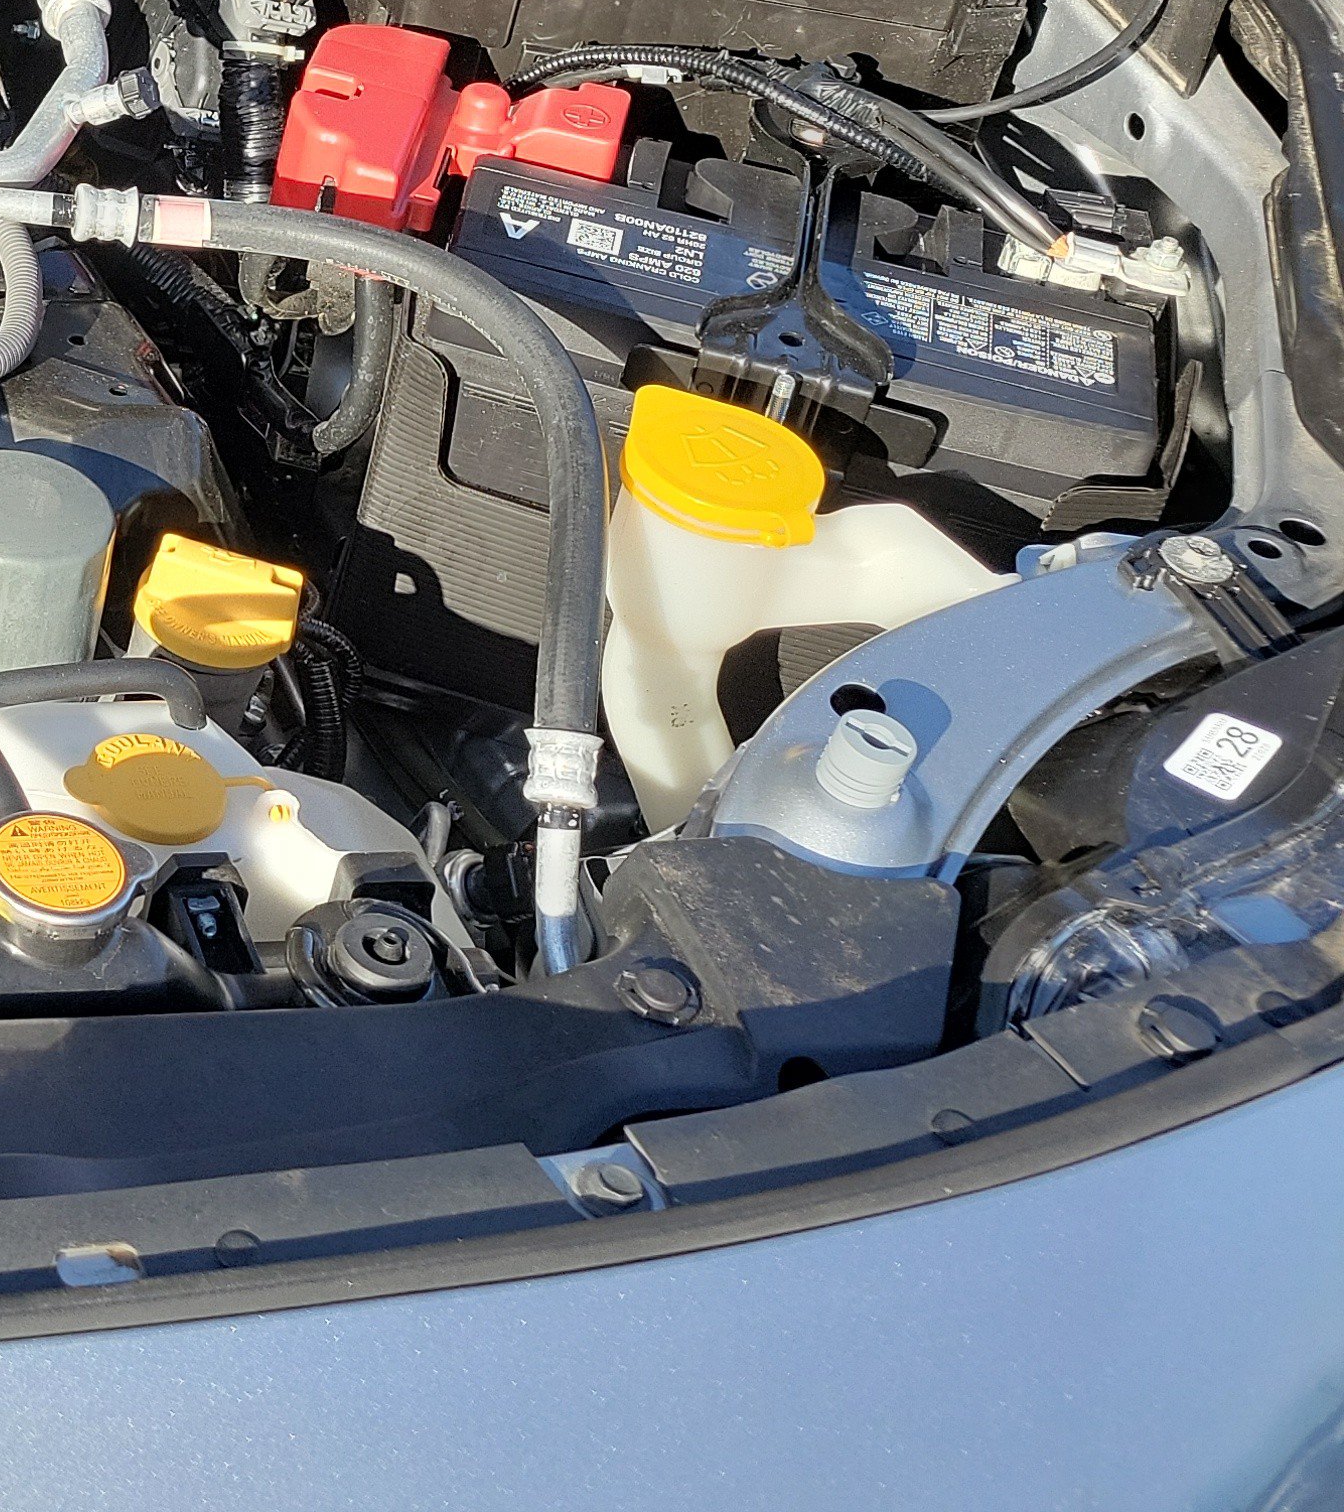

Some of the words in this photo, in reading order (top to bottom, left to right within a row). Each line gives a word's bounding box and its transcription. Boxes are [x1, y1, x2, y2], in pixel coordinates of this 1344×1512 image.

[576, 248, 608, 261] AMPS
[663, 252, 703, 267] GROUP
[674, 246, 704, 259] LN2
[609, 256, 667, 276] CRANKING
[628, 252, 673, 269] AMPS
[668, 270, 701, 284] COLD
[96, 735, 201, 768] COOLANT
[28, 824, 77, 832] WARNING
